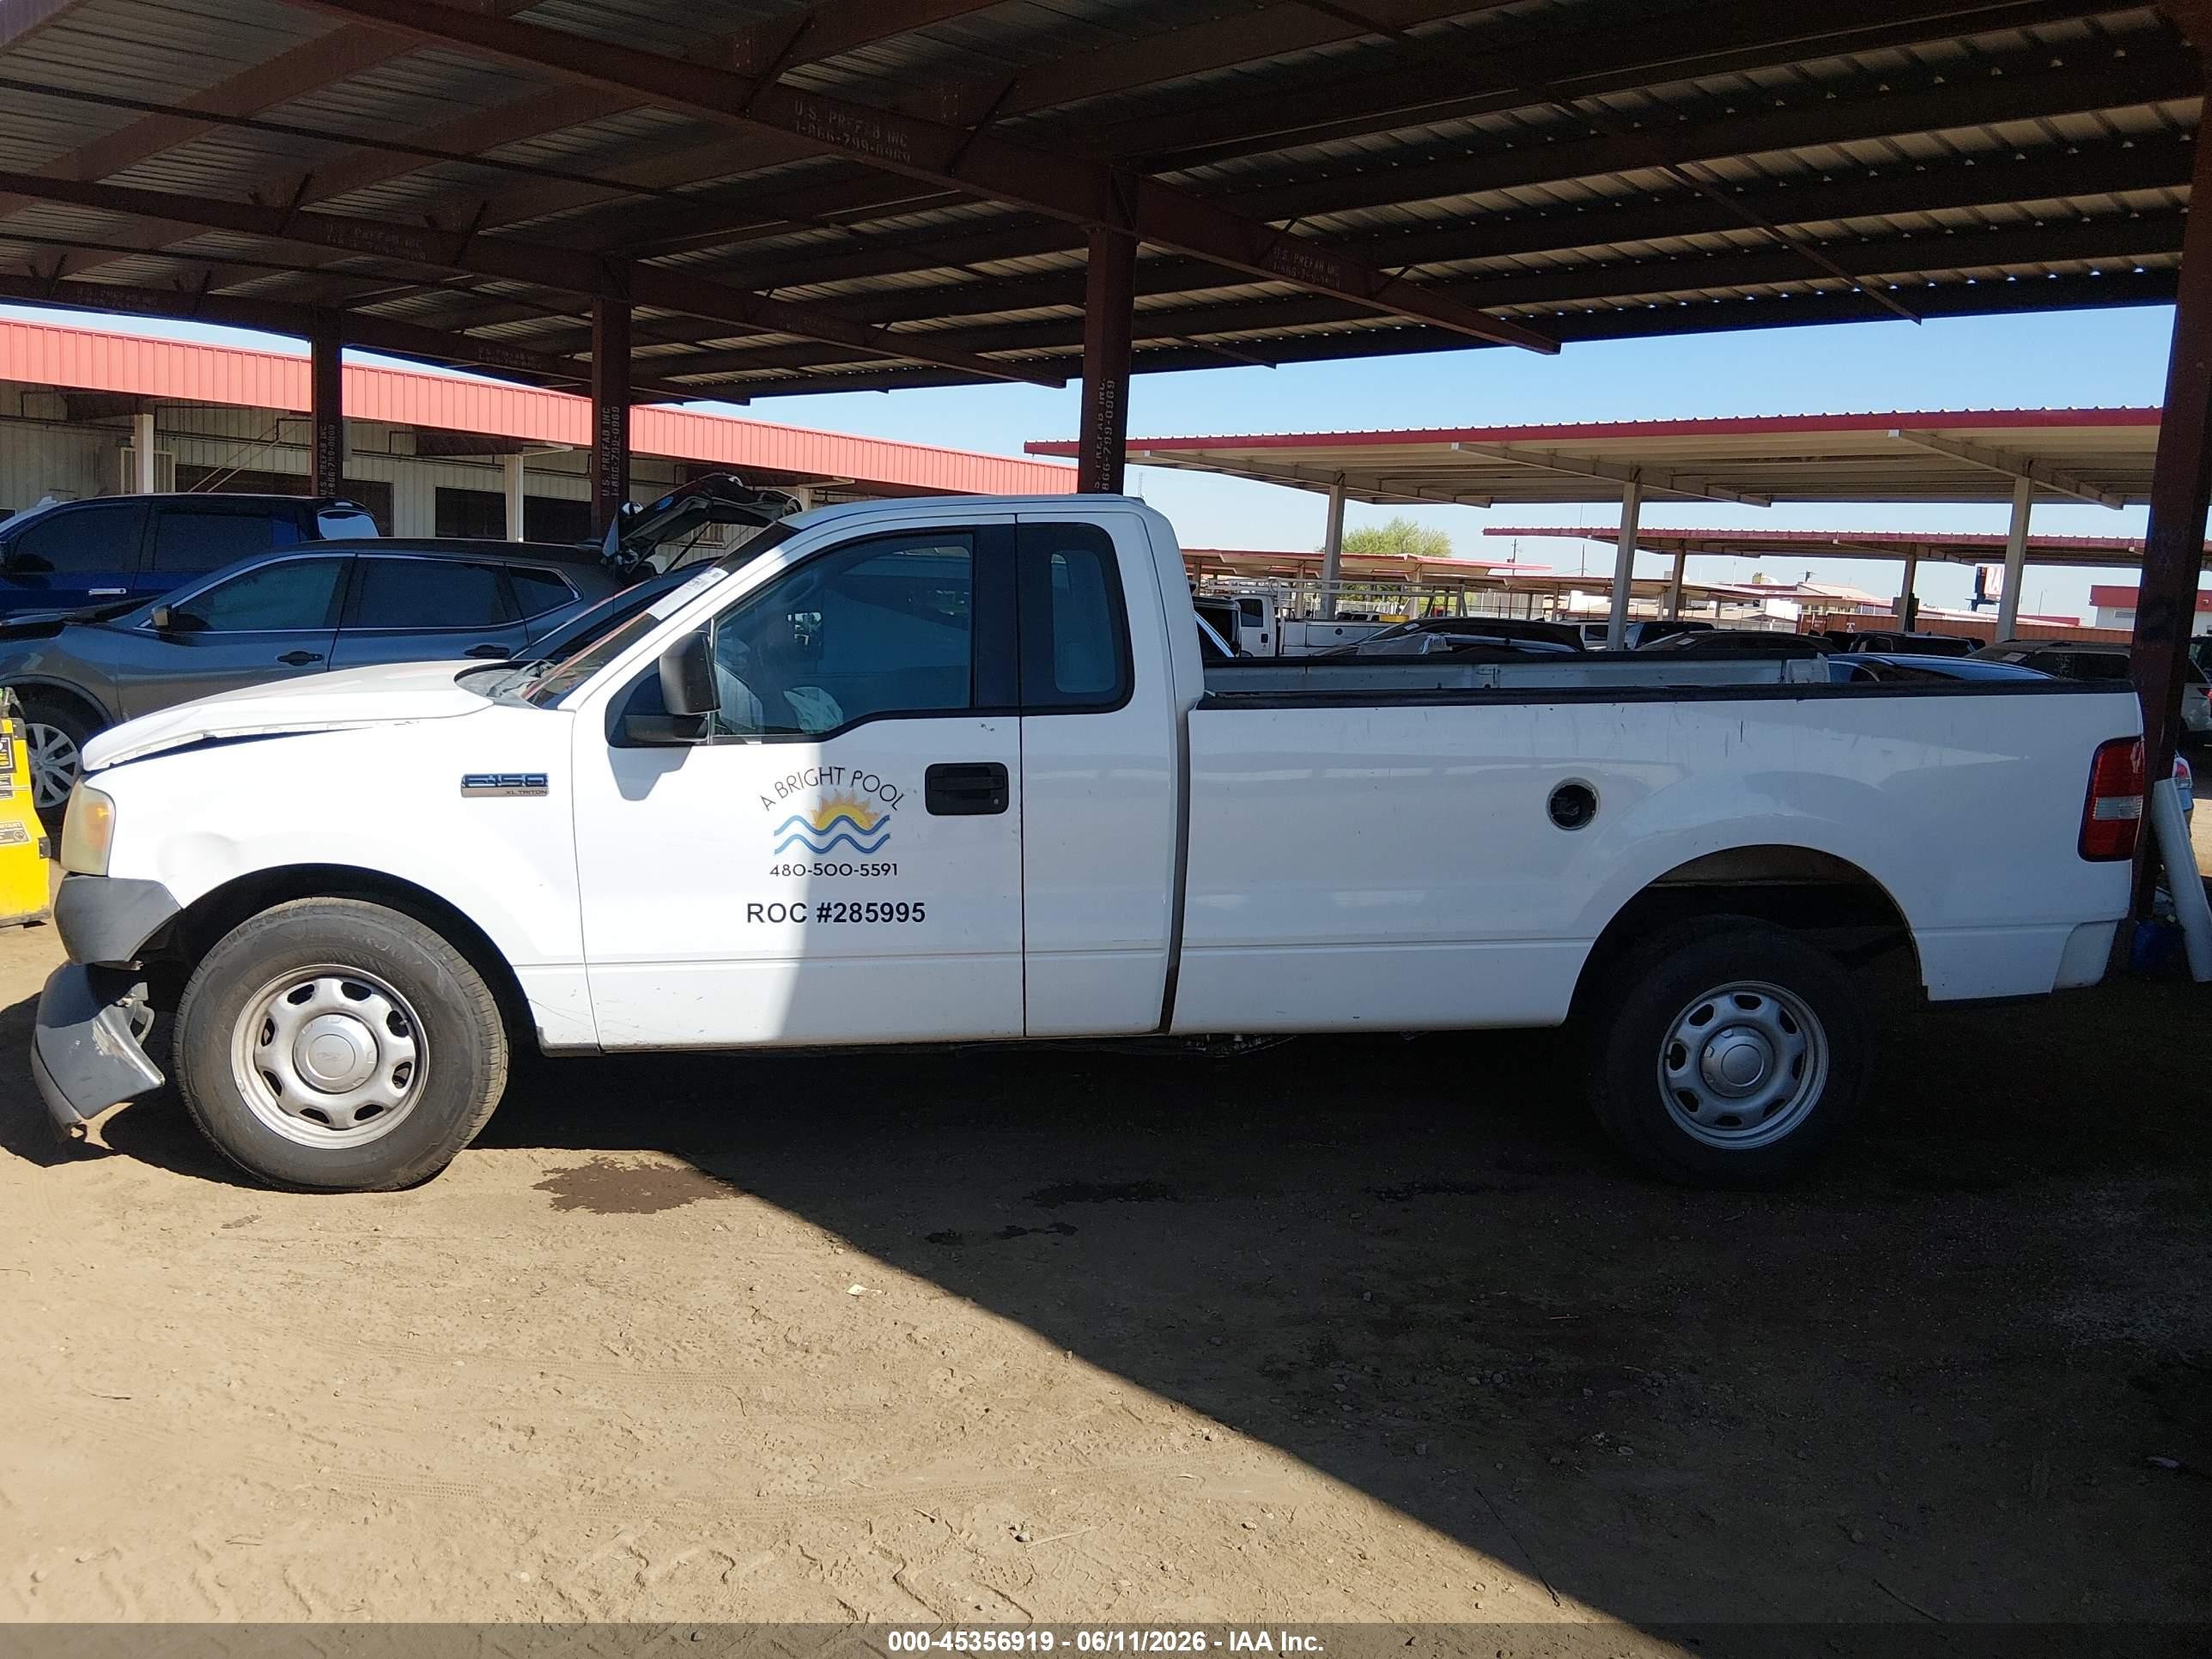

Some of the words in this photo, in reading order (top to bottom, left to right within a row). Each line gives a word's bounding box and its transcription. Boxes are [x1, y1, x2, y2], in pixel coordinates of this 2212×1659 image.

[829, 110, 880, 138] PREFB
[601, 429, 611, 471] PREFAB
[760, 794, 776, 811] A
[775, 766, 846, 799] BRIGHT
[851, 769, 906, 811] POOL
[769, 863, 899, 877] 480-500-5591
[747, 902, 807, 923] ROC
[817, 902, 926, 923] #285995
